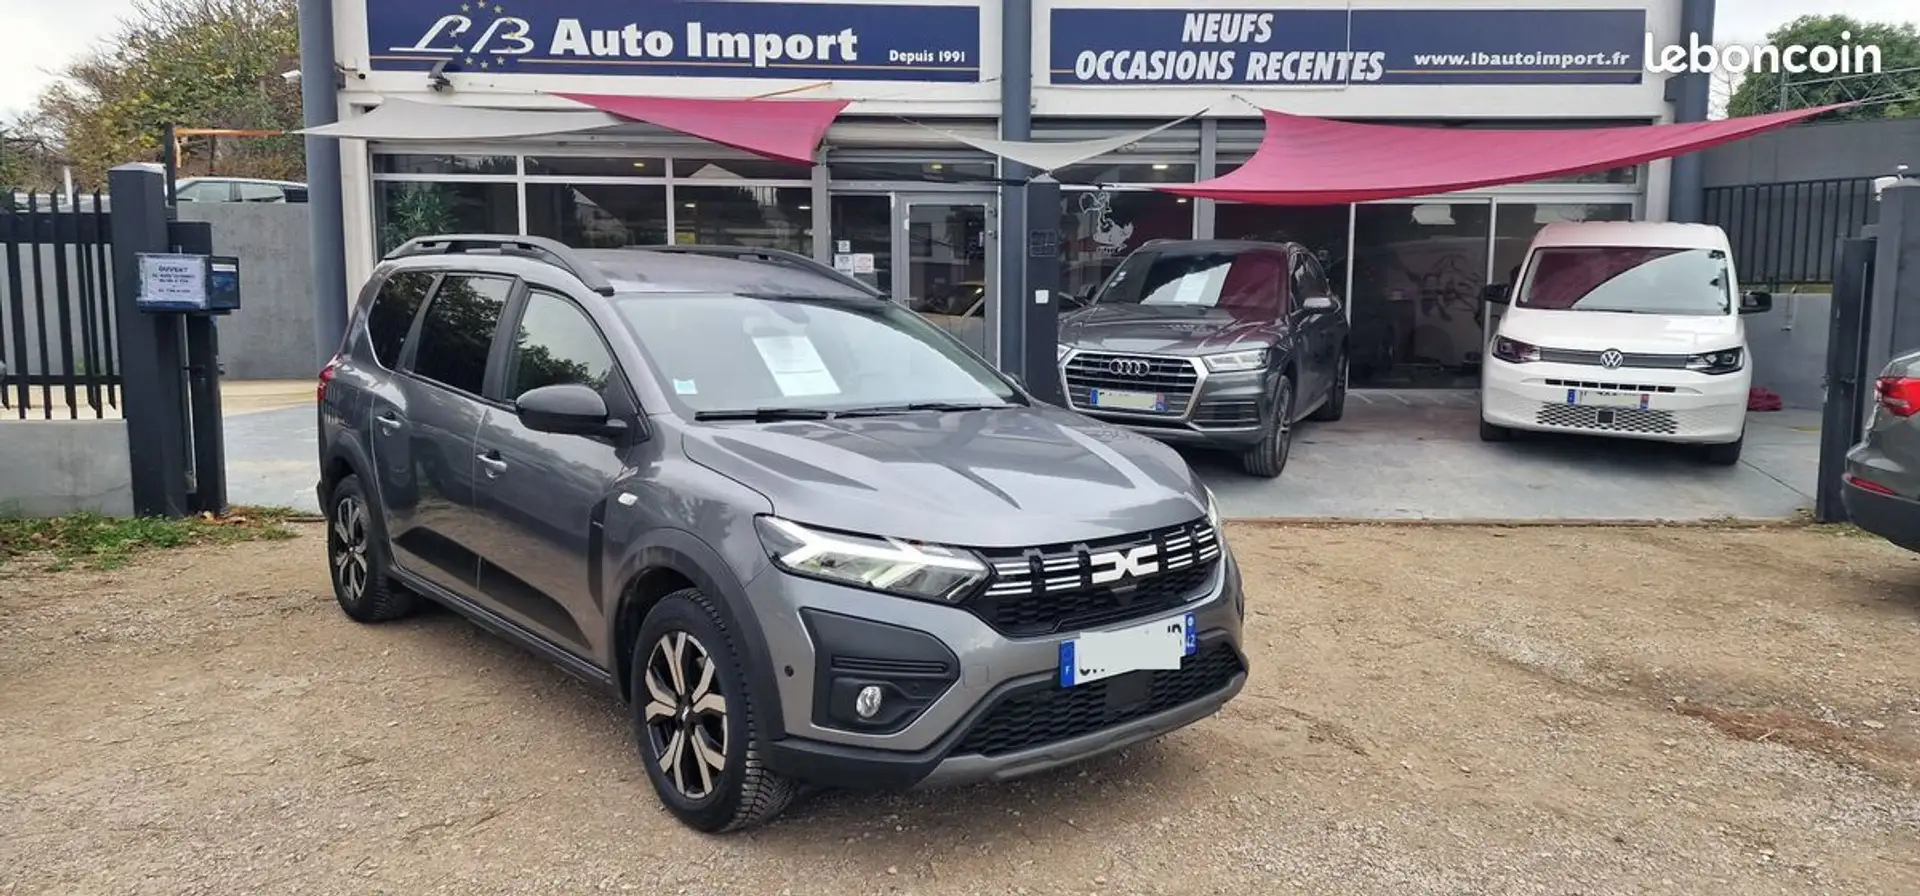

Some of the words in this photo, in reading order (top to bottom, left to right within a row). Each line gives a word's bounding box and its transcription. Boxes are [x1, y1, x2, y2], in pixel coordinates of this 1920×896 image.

[549, 18, 674, 57] Auto
[687, 21, 858, 68] Import
[1181, 12, 1274, 43] NEUFS
[889, 49, 934, 65] Depuis
[938, 50, 966, 63] 1991
[1075, 50, 1236, 81] OCCASIONS
[1245, 51, 1386, 81] RECENTES
[1413, 51, 1630, 69] www.lbautoimport.fr
